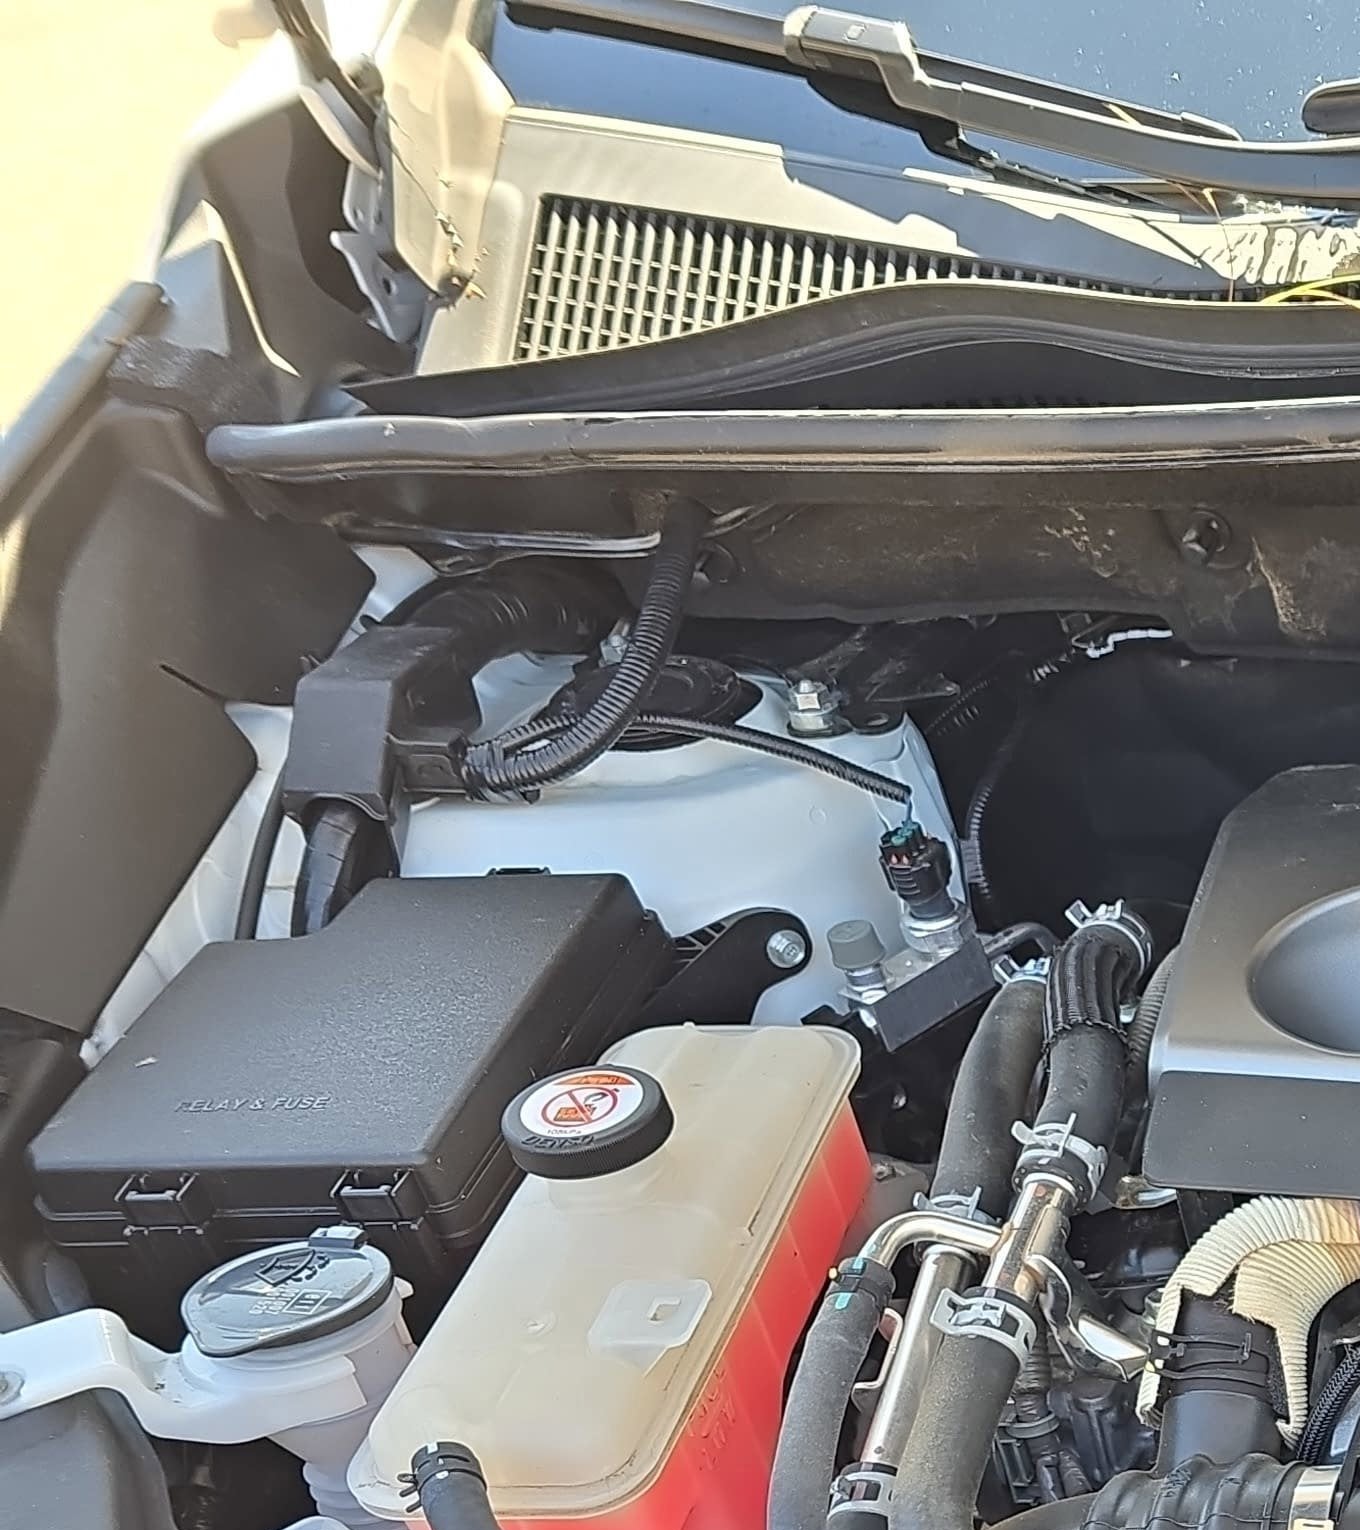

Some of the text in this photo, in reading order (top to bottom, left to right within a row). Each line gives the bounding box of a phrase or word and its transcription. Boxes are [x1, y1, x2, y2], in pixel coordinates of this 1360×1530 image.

[174, 1095, 332, 1113] RELAY & FUSE
